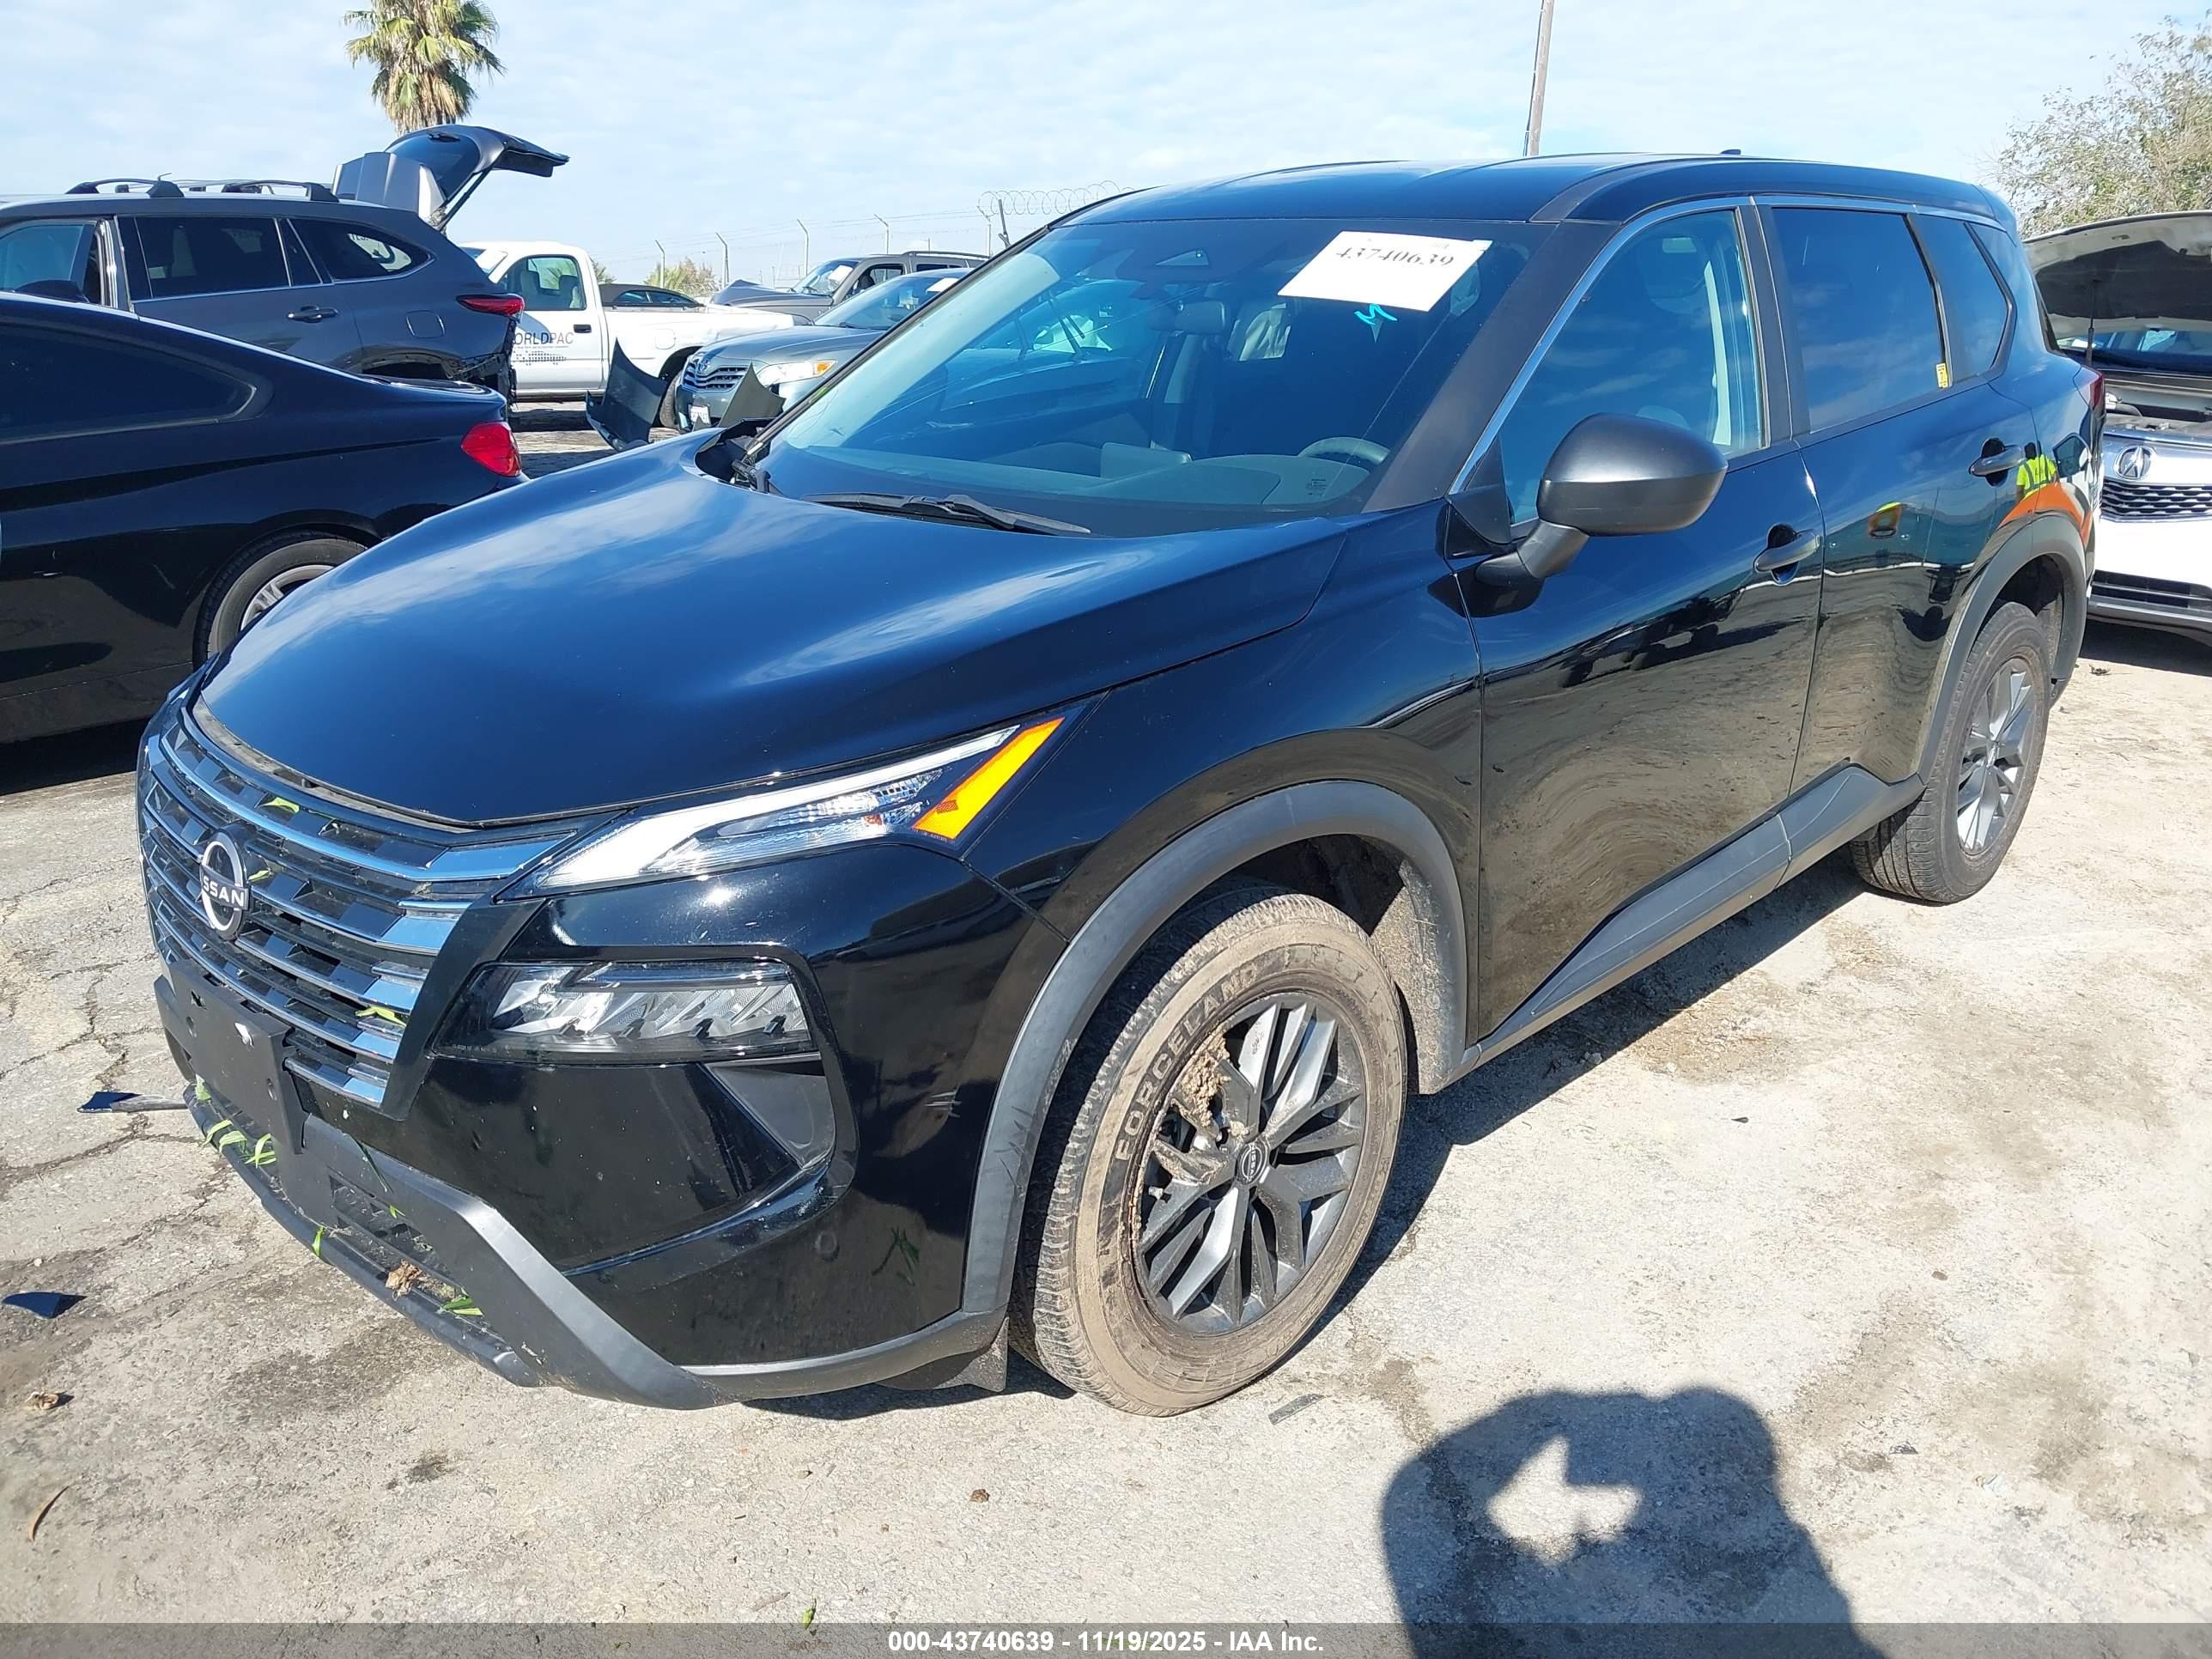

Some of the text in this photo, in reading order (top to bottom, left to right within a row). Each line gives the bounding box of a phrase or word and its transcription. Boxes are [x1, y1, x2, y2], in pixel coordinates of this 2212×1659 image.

[1336, 246, 1454, 266] 43740639
[514, 331, 574, 345] ORLDPAC
[203, 875, 245, 907] SSAN
[1115, 967, 1256, 1160] FORCELAND
